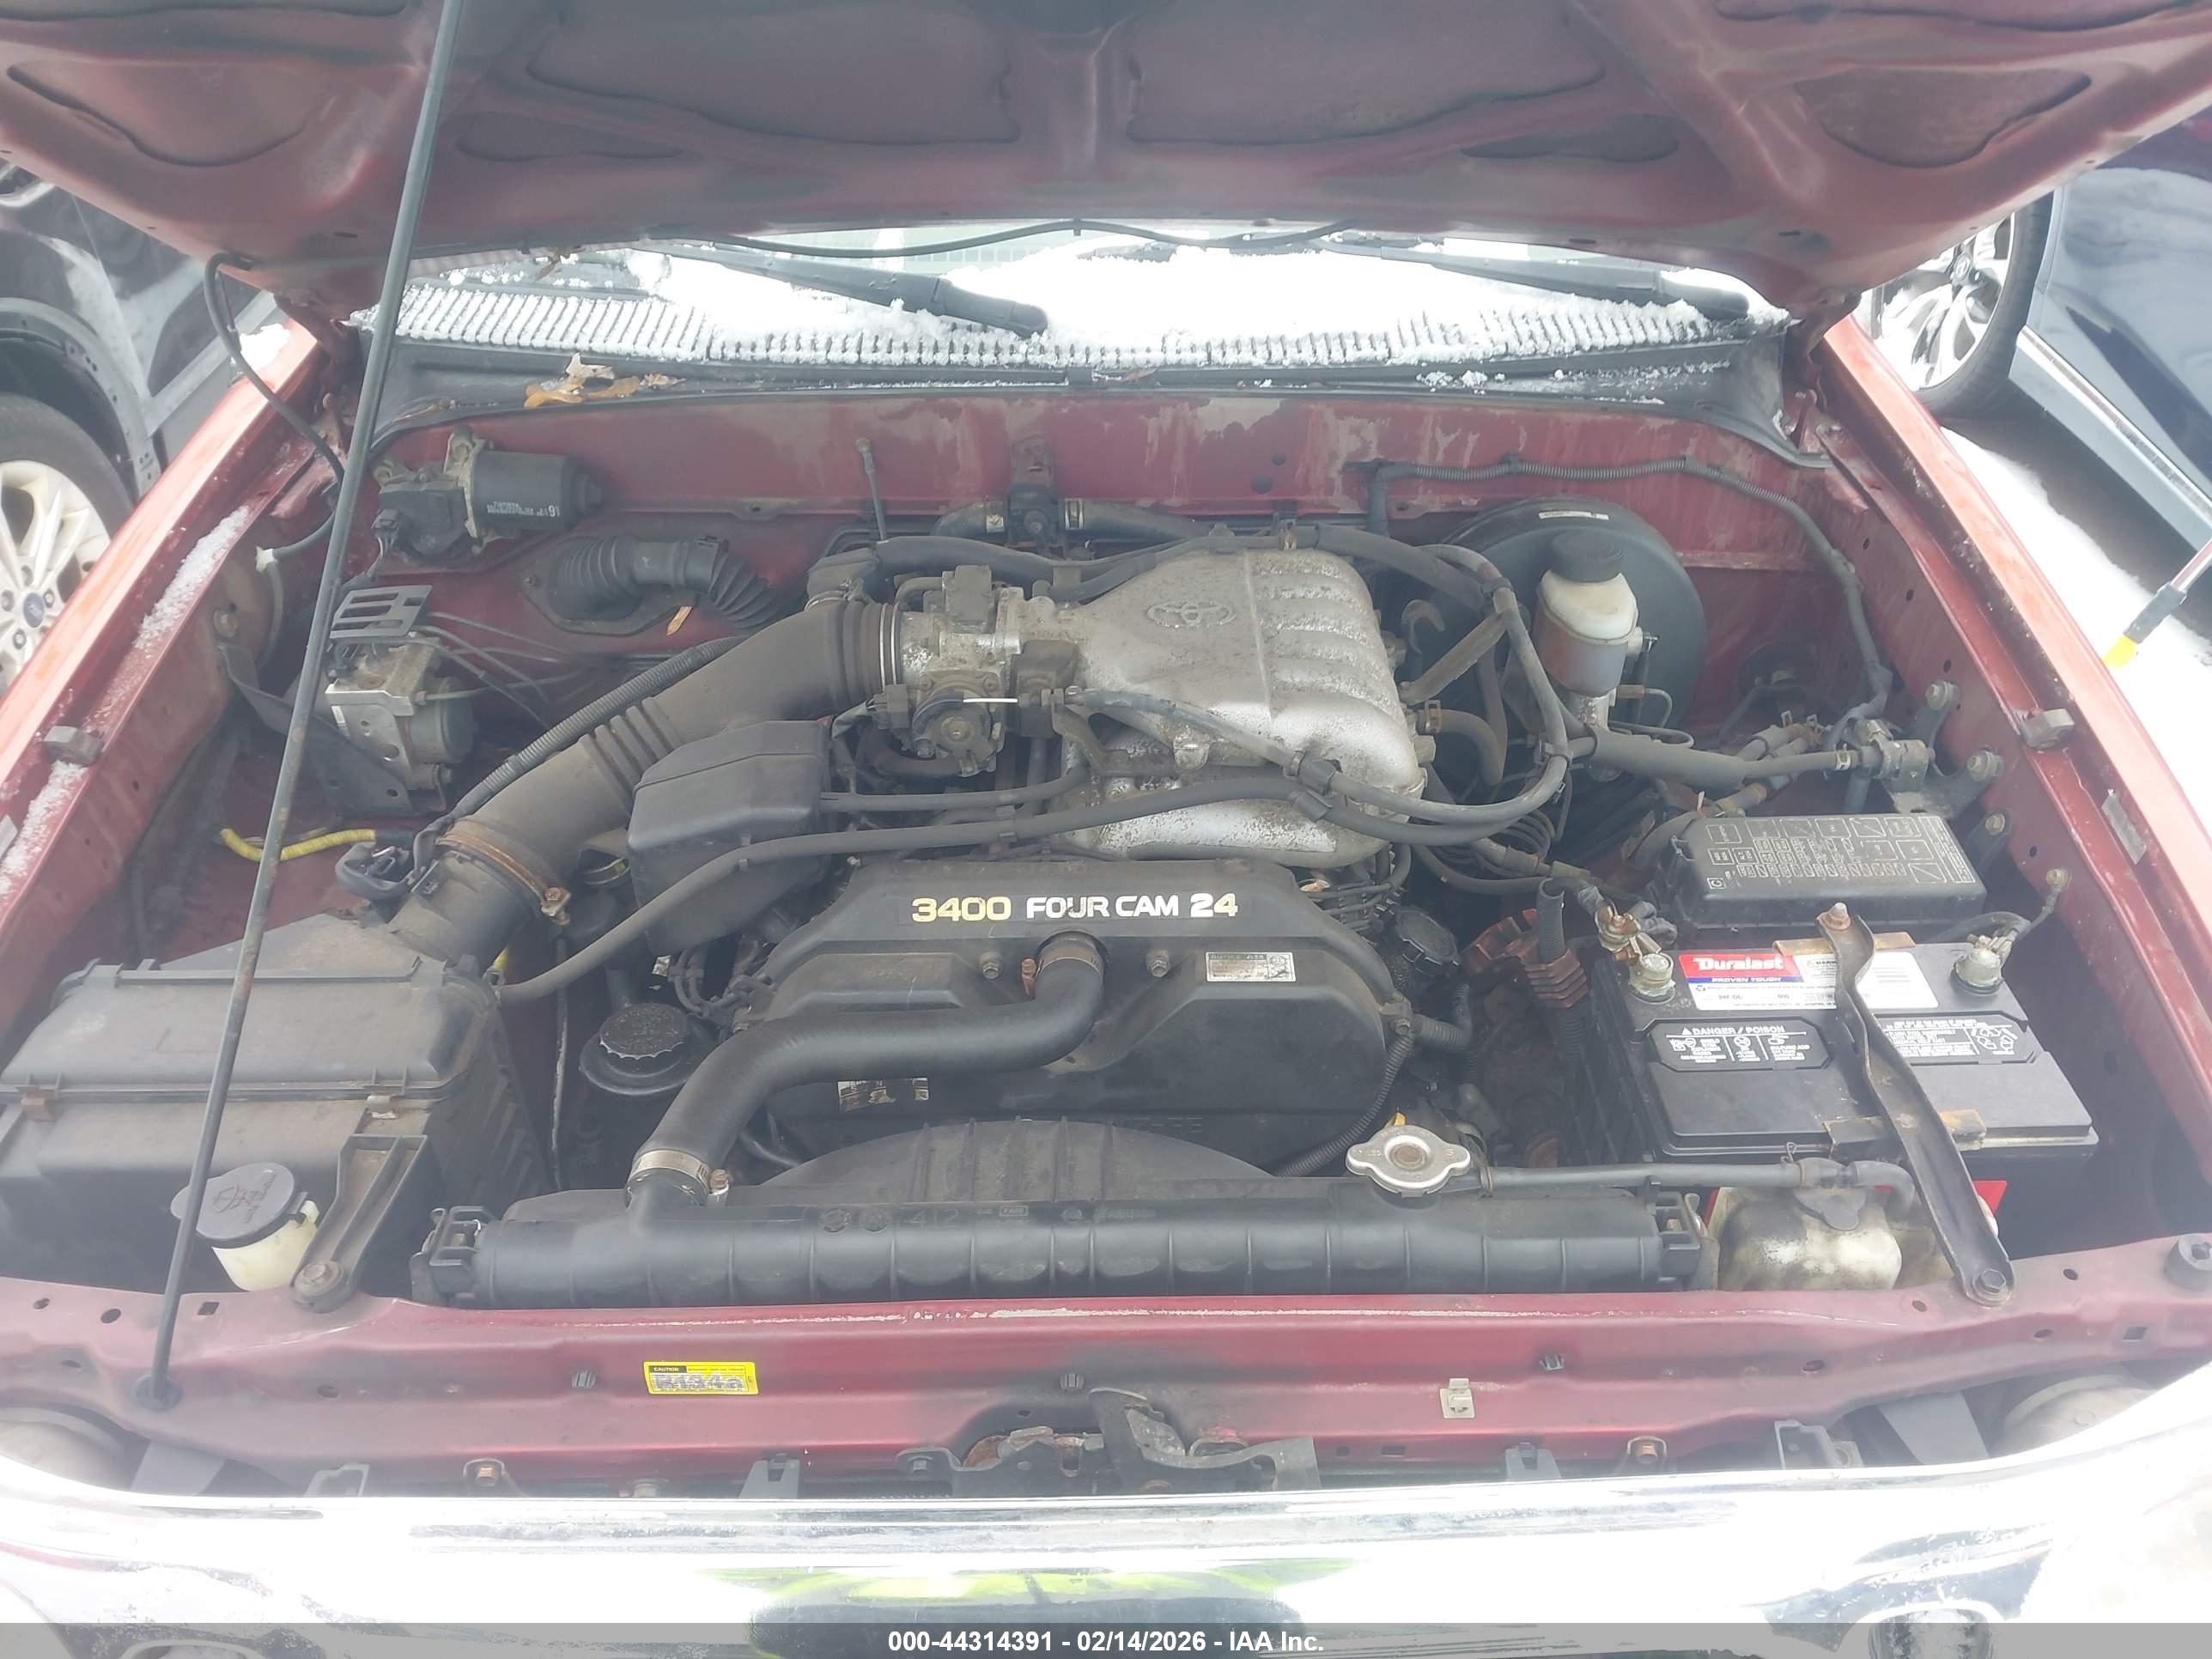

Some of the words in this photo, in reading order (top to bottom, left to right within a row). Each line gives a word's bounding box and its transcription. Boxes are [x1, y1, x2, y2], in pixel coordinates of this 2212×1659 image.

[912, 896, 1012, 922] 3400
[1026, 896, 1109, 919] FOUR
[1115, 895, 1179, 917] CAM
[1190, 893, 1238, 918] 24
[1694, 957, 1784, 971] Duralast
[1692, 1027, 1737, 1036] DANGER
[1745, 1025, 1786, 1035] POISON
